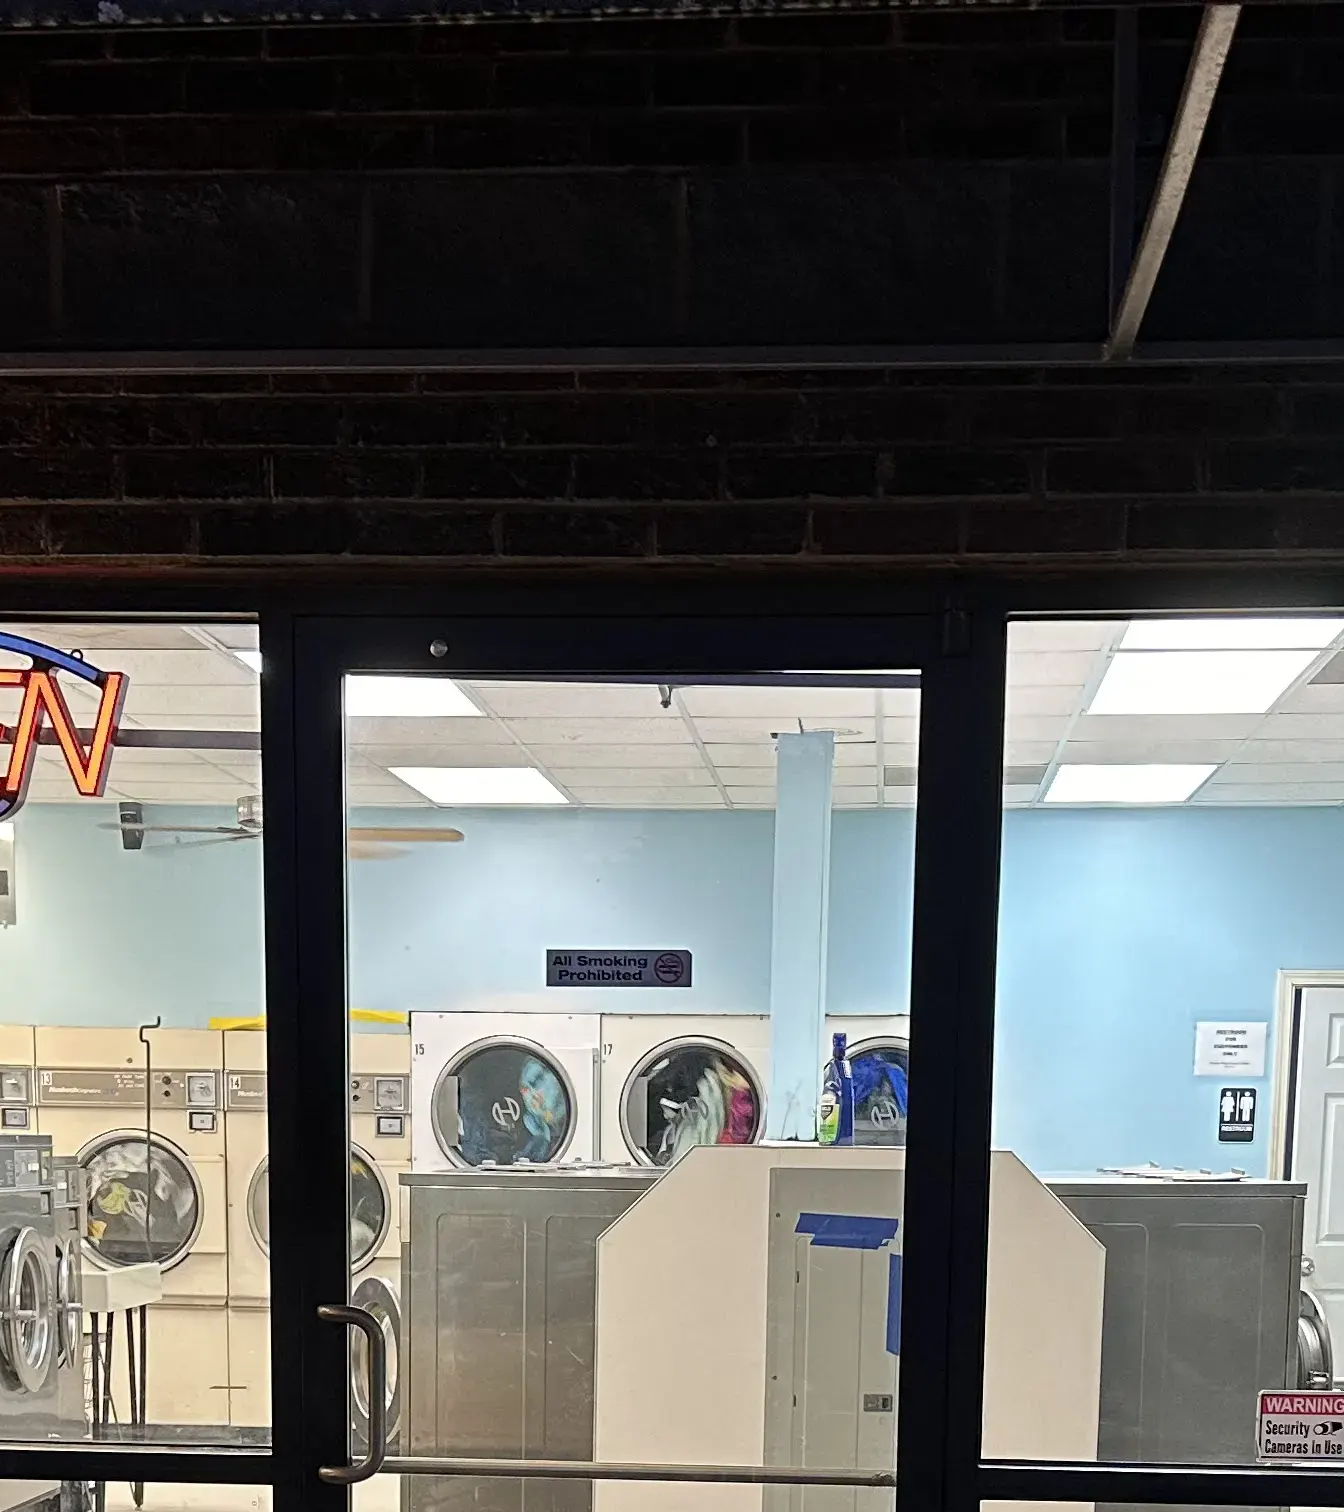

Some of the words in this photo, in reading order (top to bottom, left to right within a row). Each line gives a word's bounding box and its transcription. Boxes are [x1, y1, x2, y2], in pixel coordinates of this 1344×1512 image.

[552, 955, 572, 967] All
[577, 955, 648, 969] Smoking
[558, 969, 643, 981] Prohibited
[415, 1043, 425, 1056] 15
[603, 1043, 613, 1056] 17
[41, 1072, 52, 1086] 13
[230, 1076, 240, 1090] 14
[1265, 1420, 1311, 1438] Security
[1264, 1439, 1308, 1454] Cameras
[1324, 1440, 1343, 1454] Use
